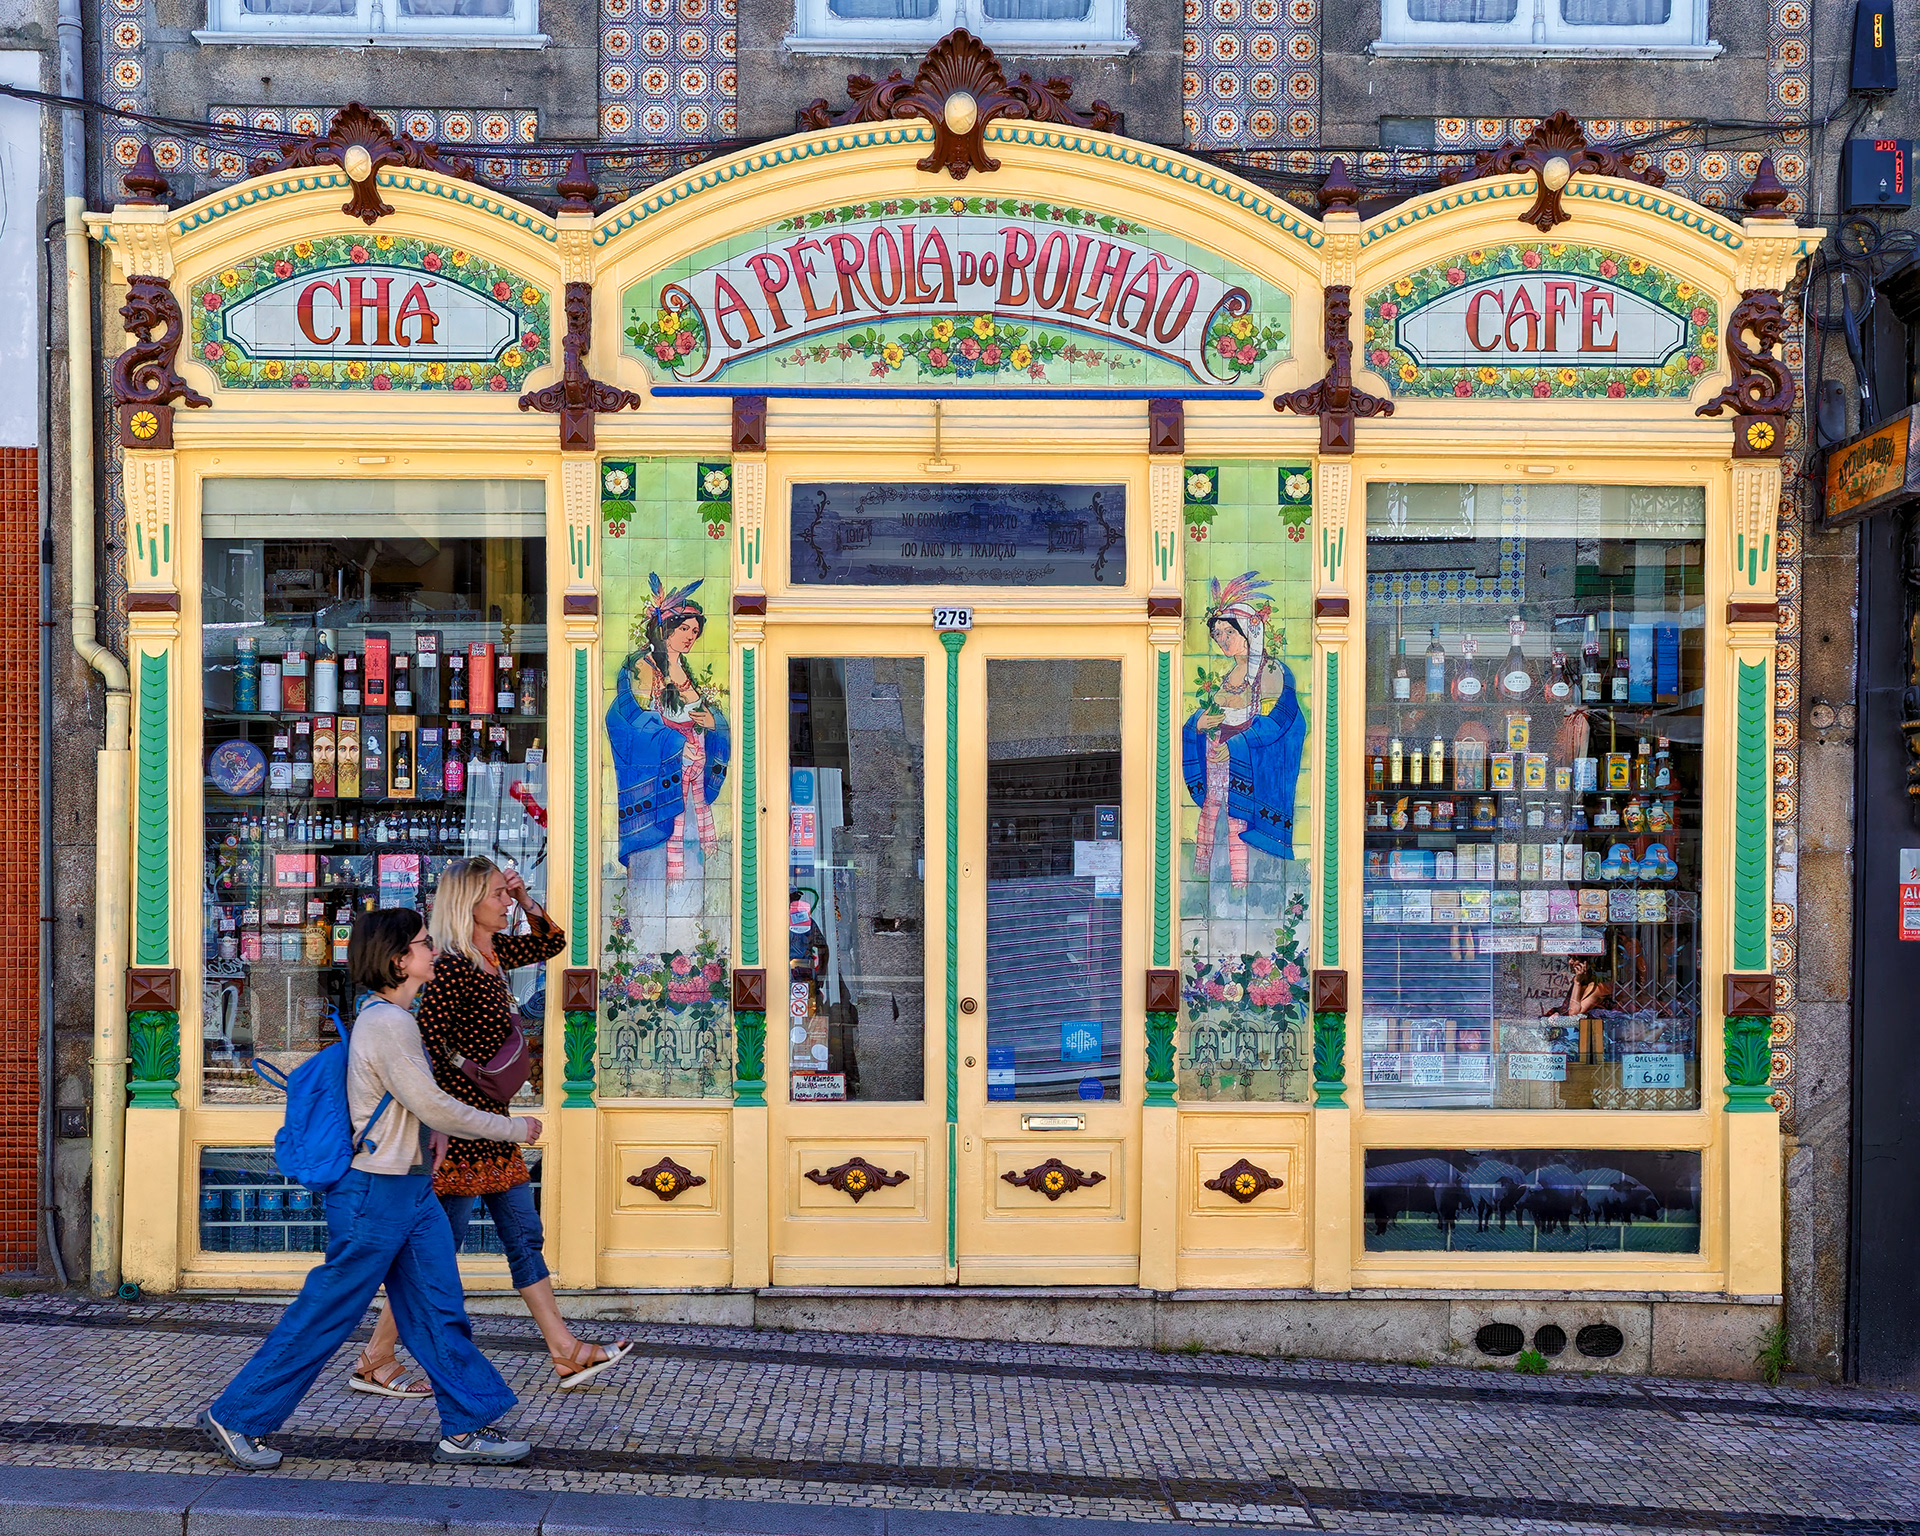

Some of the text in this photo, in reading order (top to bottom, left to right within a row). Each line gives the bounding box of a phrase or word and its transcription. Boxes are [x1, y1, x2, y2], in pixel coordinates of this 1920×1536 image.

[1875, 15, 1883, 46] 545
[1875, 141, 1896, 150] PDO
[1895, 151, 1903, 191] 4137
[713, 223, 1200, 348] A PÉROLA DO BOLHÃO
[297, 276, 440, 347] CHÁ
[1466, 281, 1618, 352] CAFÉ
[901, 513, 914, 527] NO
[844, 528, 865, 544] 1917
[1057, 529, 1077, 544] 2017
[900, 543, 918, 557] 100
[920, 541, 945, 557] ANOS
[951, 543, 963, 557] DE
[938, 611, 967, 626] 279
[1101, 814, 1115, 822] MB
[1903, 886, 1920, 899] Al
[1643, 1071, 1670, 1083] 6.00
